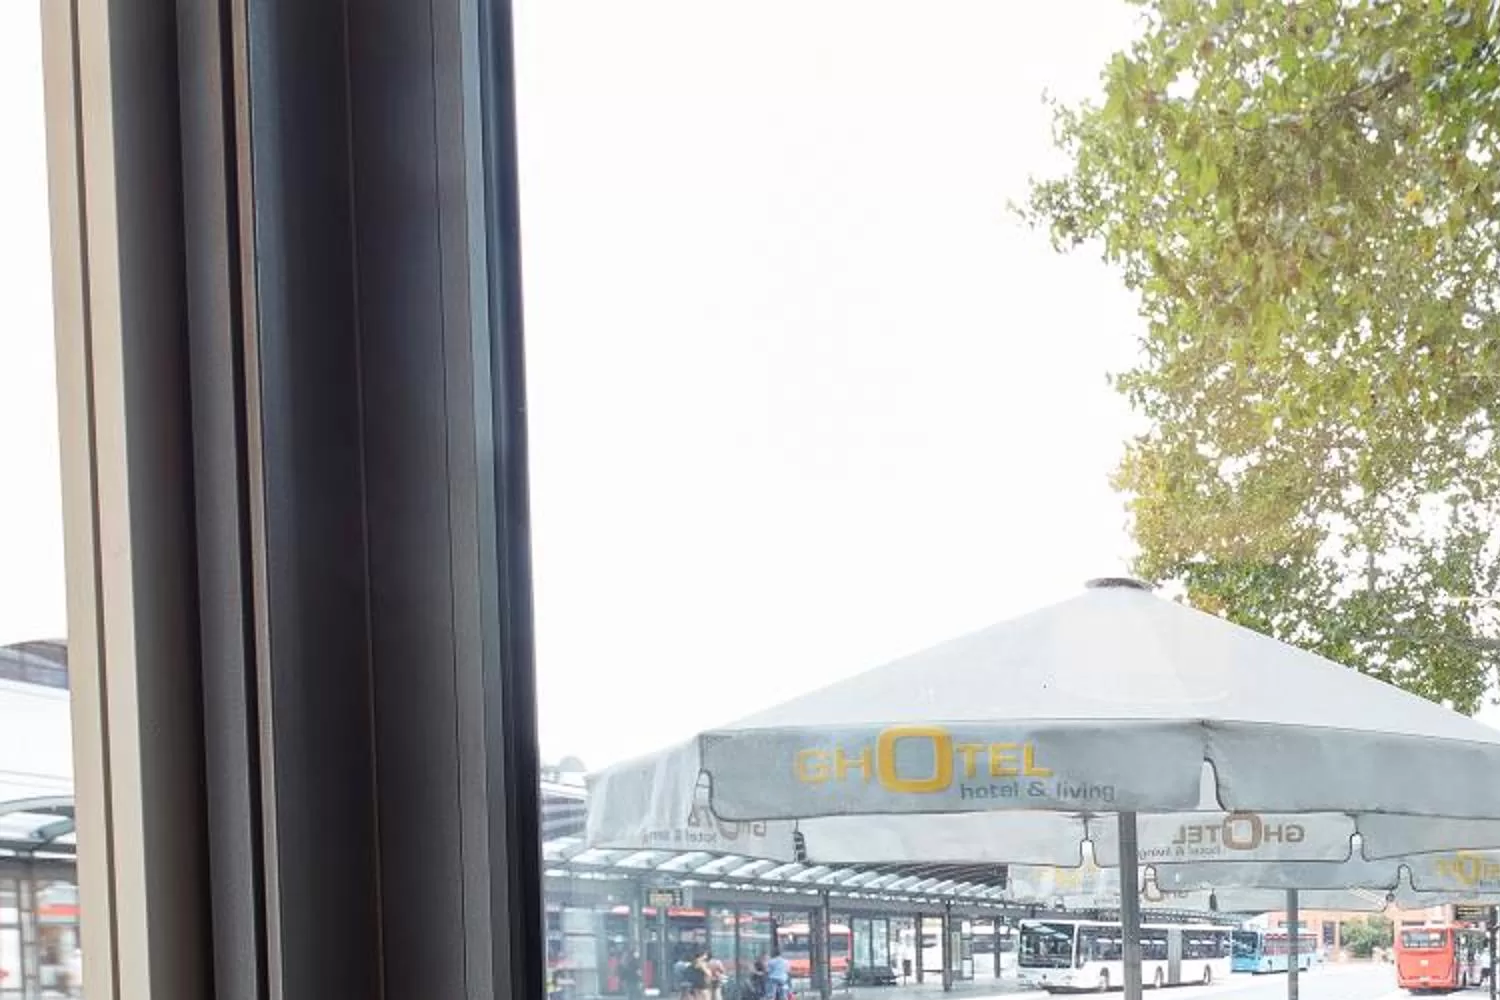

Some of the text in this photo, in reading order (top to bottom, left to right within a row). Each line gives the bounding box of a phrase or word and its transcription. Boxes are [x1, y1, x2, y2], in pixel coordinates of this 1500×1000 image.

[794, 725, 1054, 795] GHOTEL
[960, 780, 1115, 802] hotel & living
